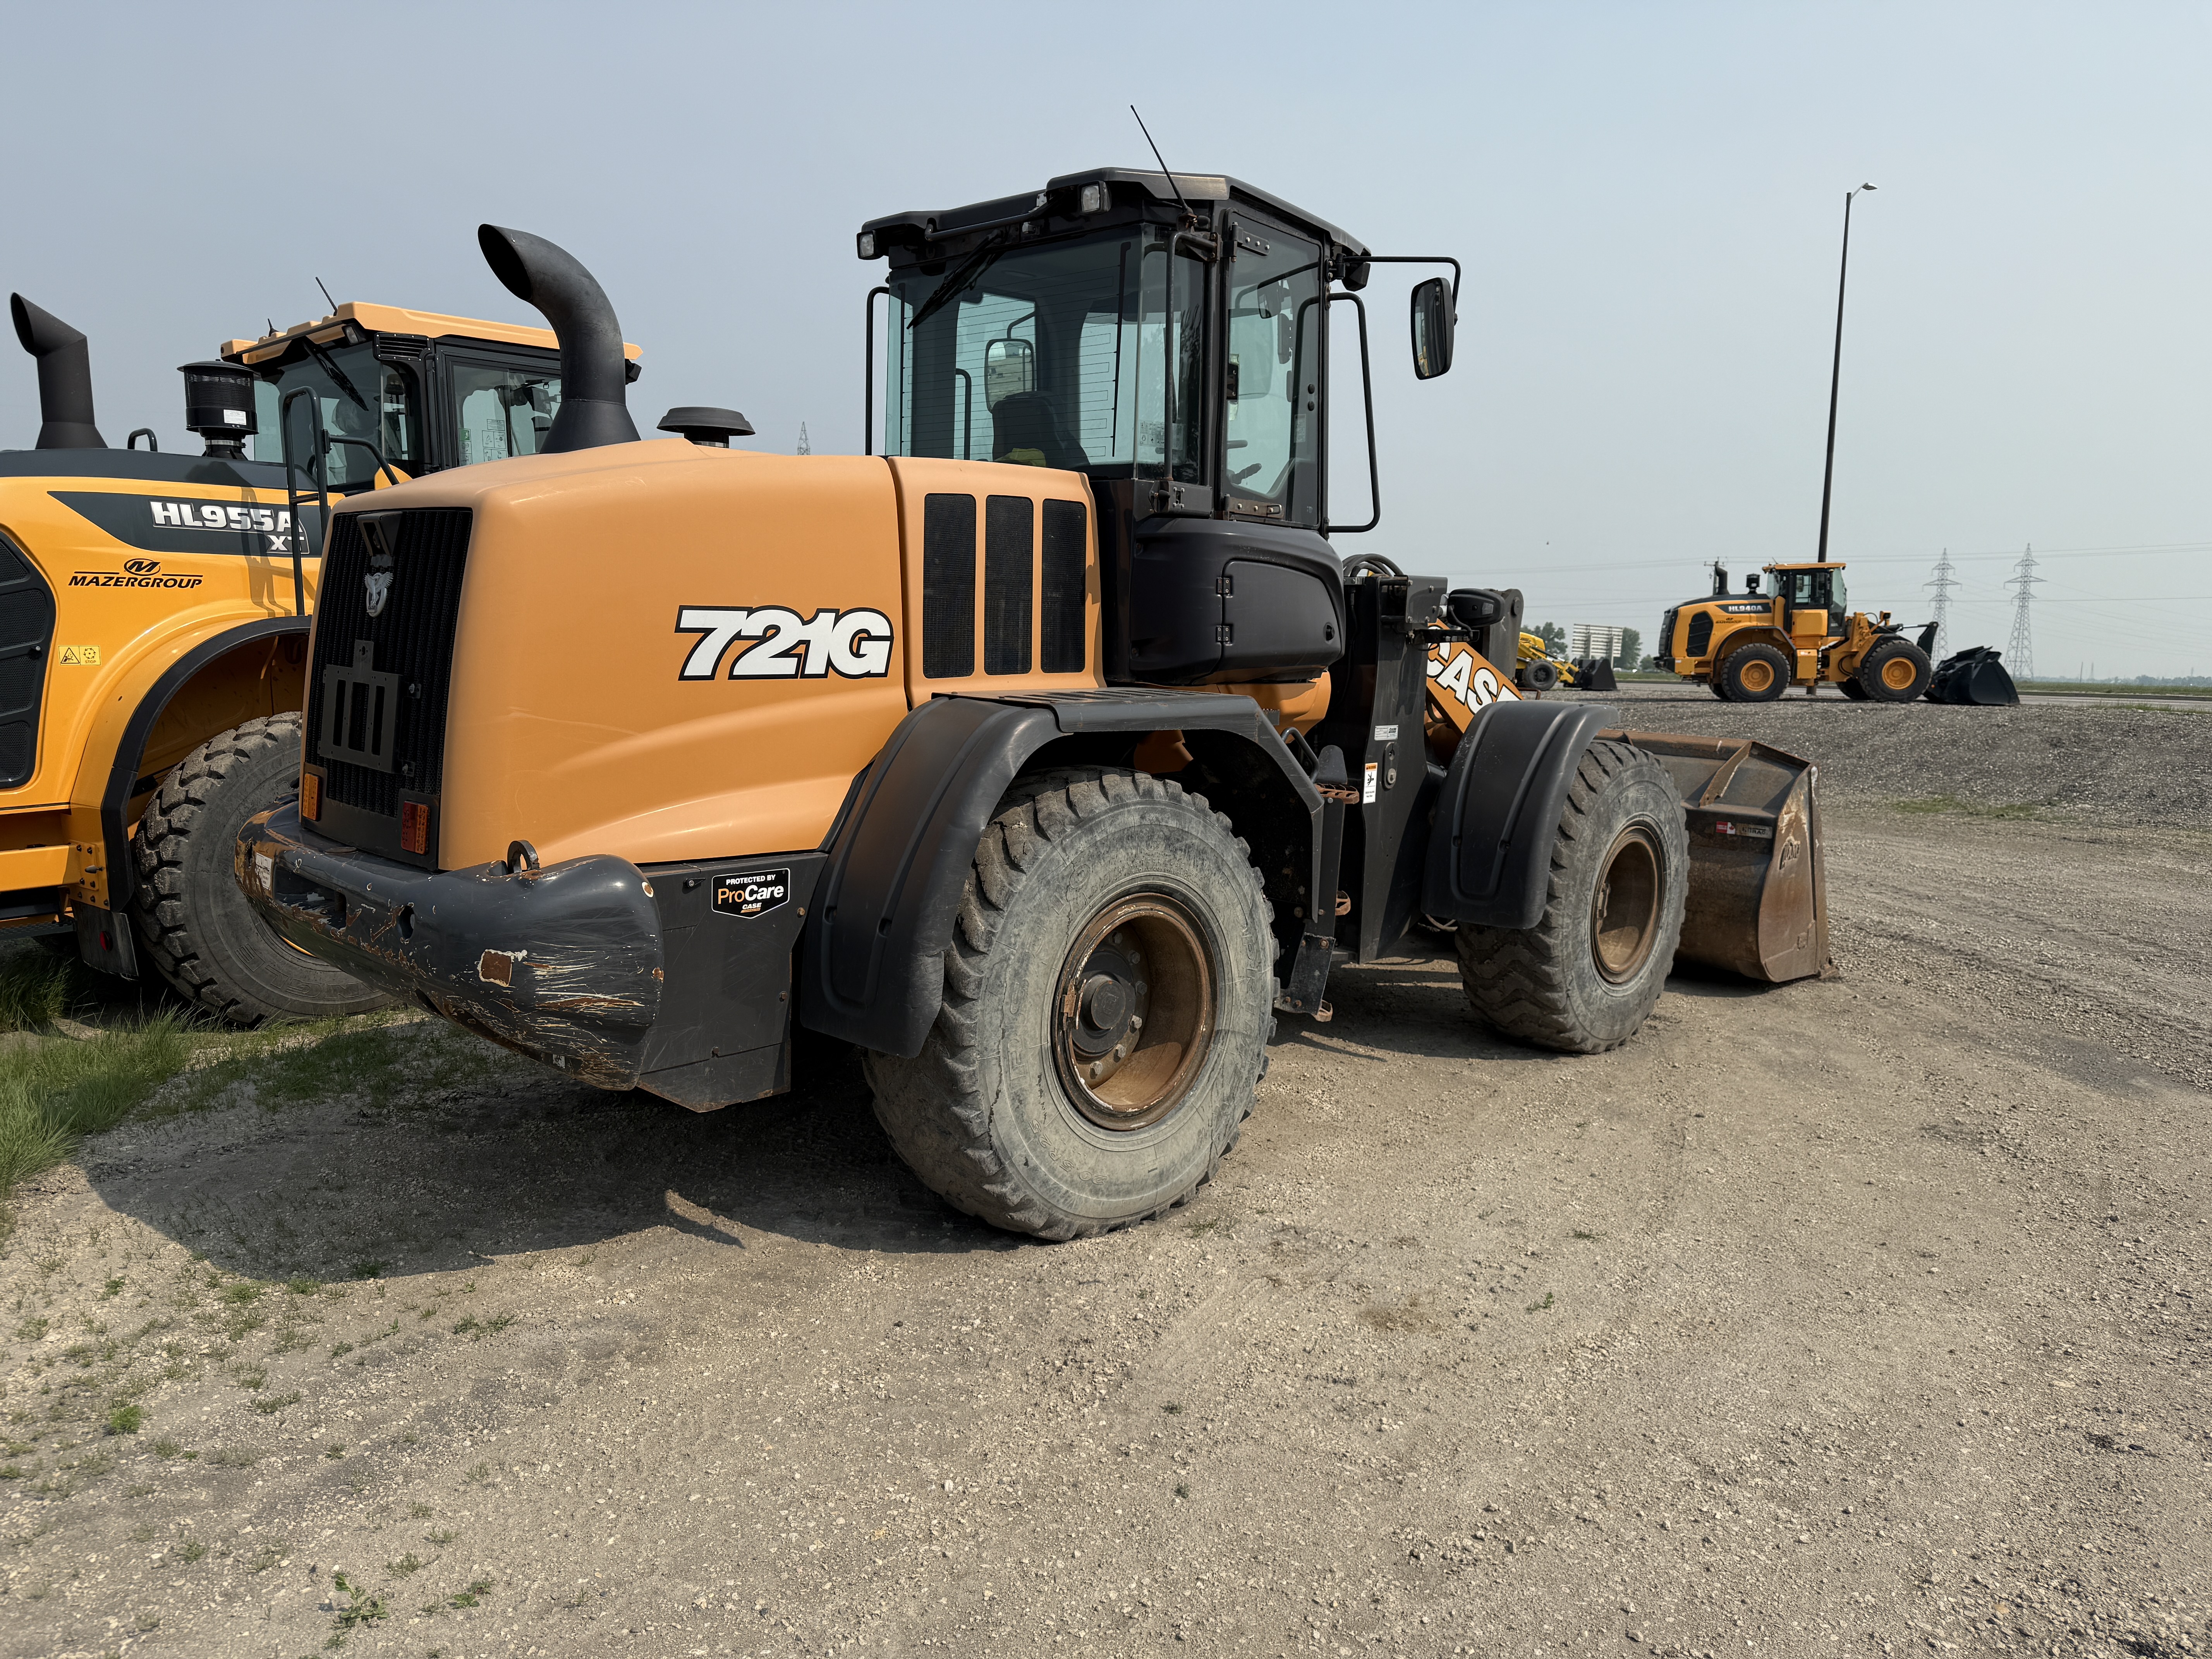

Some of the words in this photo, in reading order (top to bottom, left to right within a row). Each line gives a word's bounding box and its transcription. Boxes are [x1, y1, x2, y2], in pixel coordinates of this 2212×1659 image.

[150, 501, 303, 532] HL955A
[68, 575, 203, 589] MAZERGROUP
[674, 605, 895, 681] 721G
[1427, 624, 1523, 716] CAS
[726, 875, 766, 885] PROTECTED
[718, 884, 785, 905] ProCare
